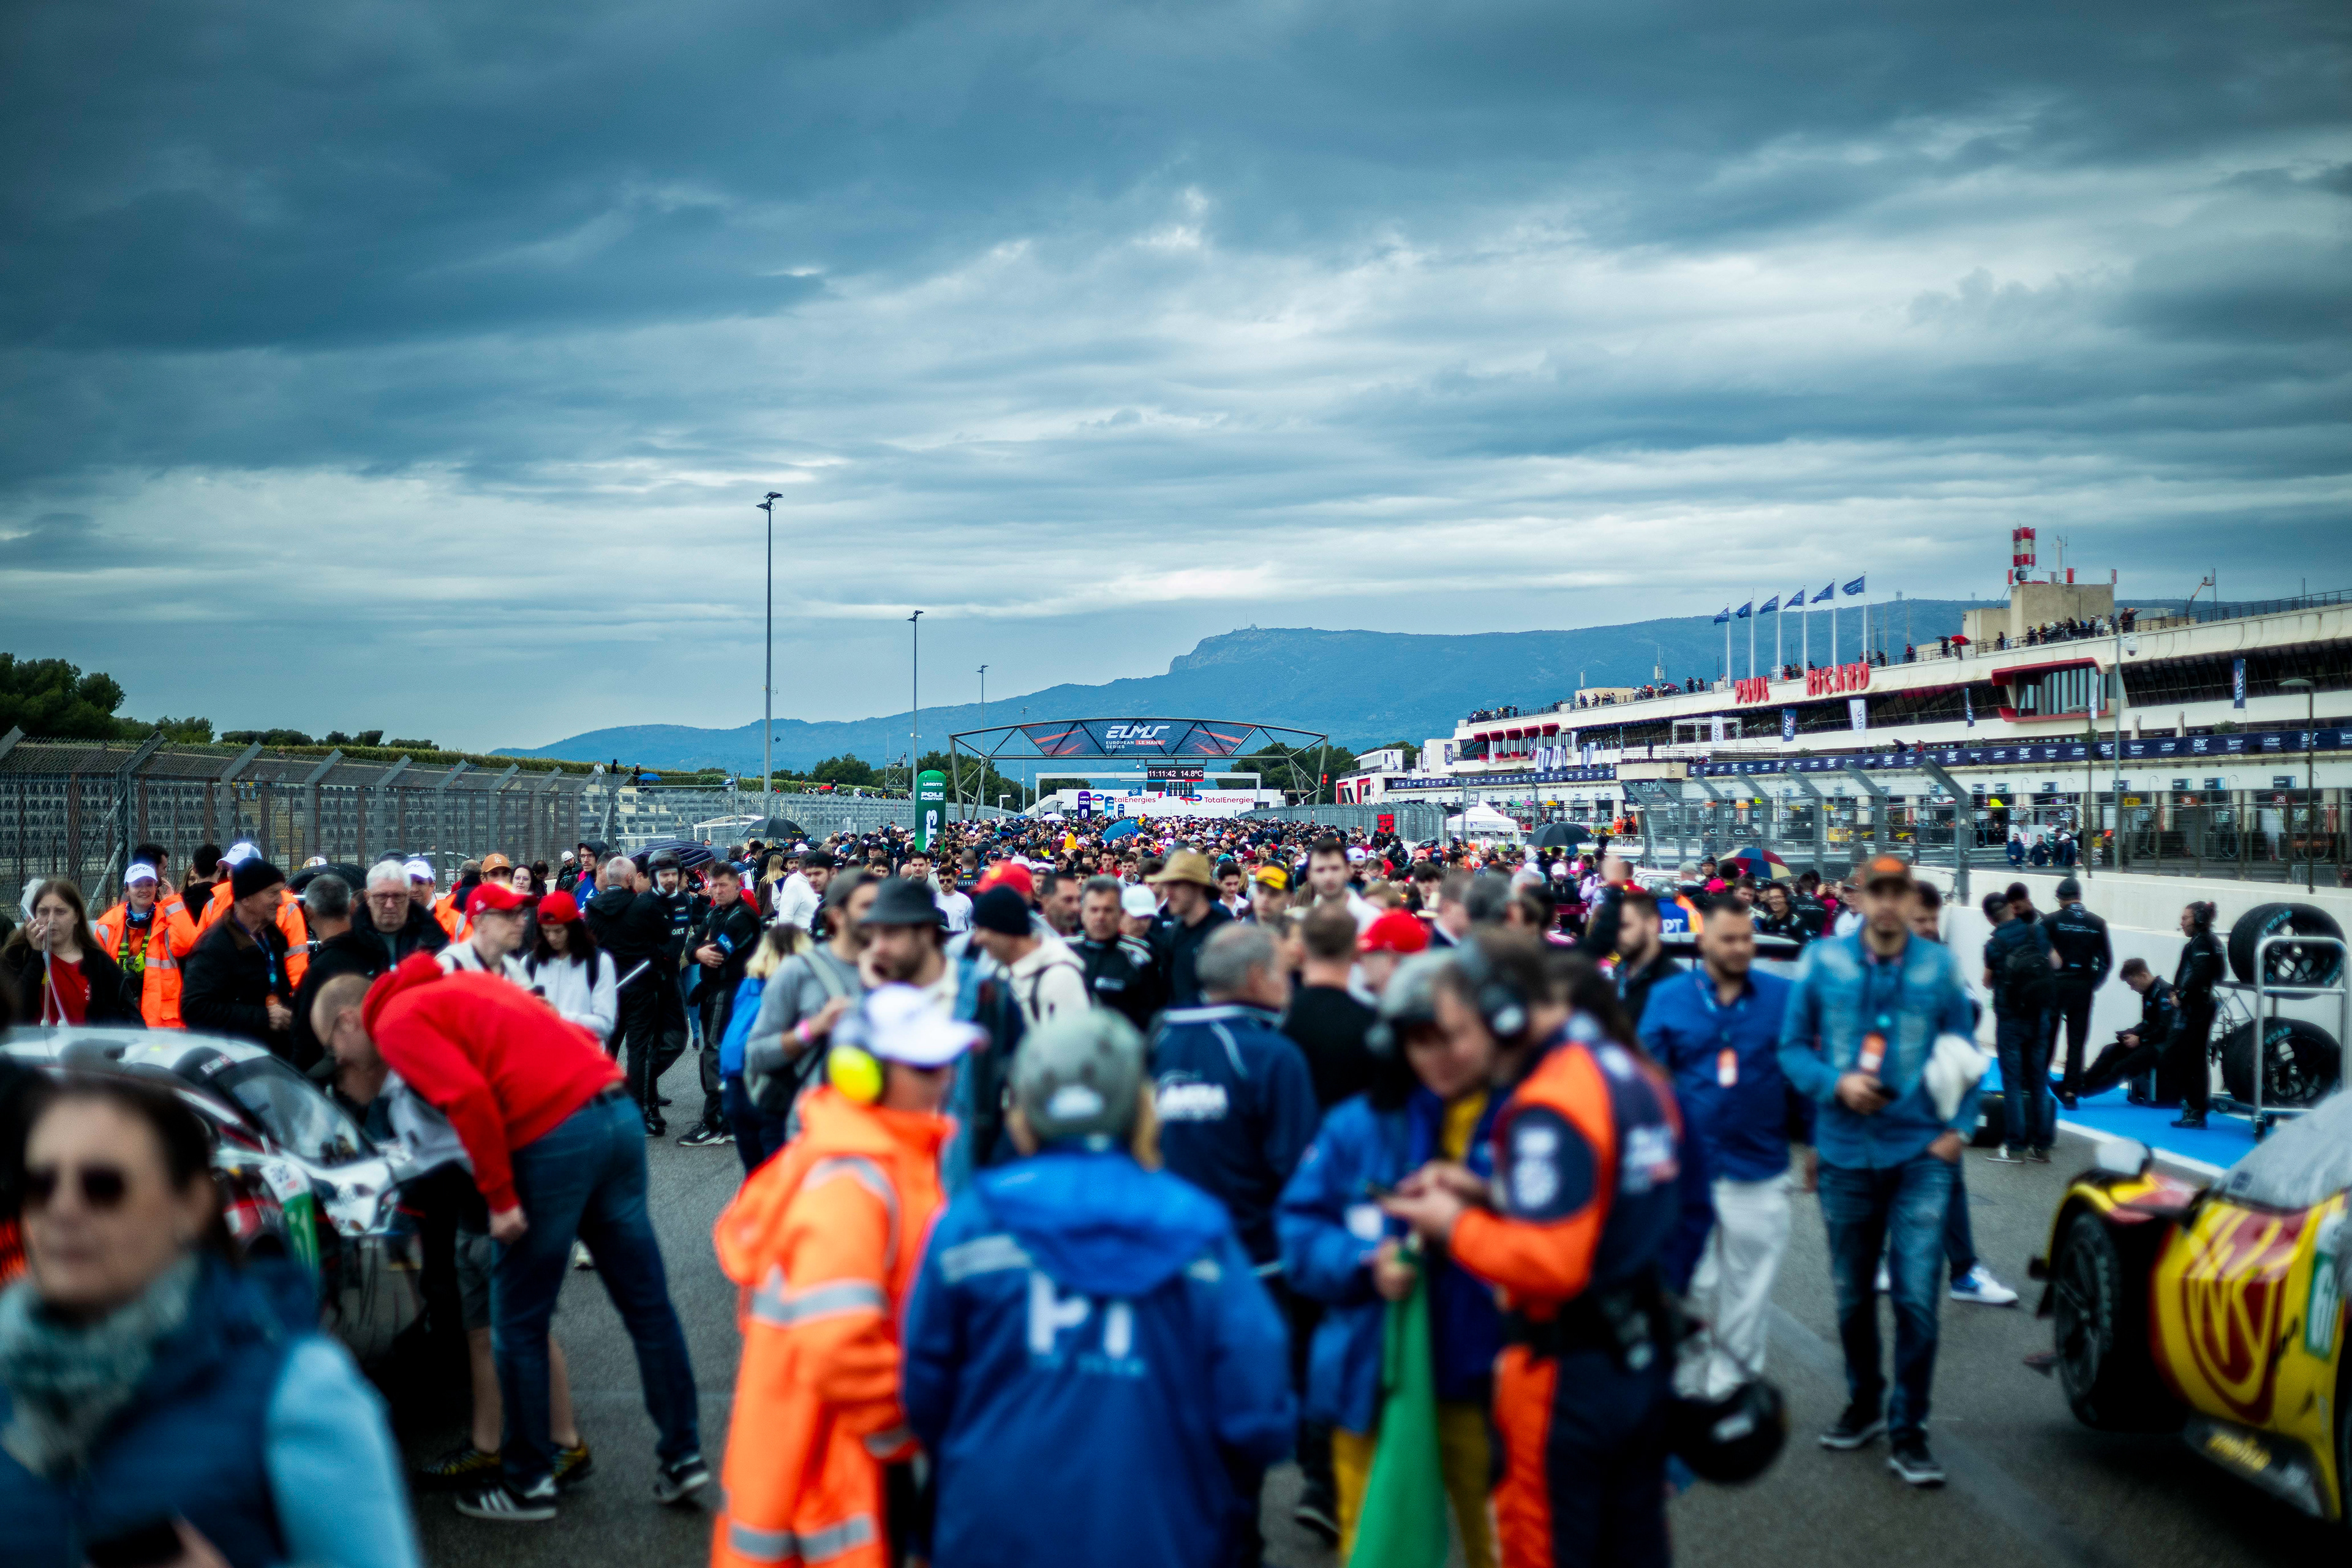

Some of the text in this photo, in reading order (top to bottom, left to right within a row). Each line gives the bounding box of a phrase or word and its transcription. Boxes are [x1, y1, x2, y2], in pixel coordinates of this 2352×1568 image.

[1735, 663, 1869, 704] PAUL RICARD
[1106, 725, 1170, 739] ELMS
[1204, 796, 1254, 805] TotalEnergies
